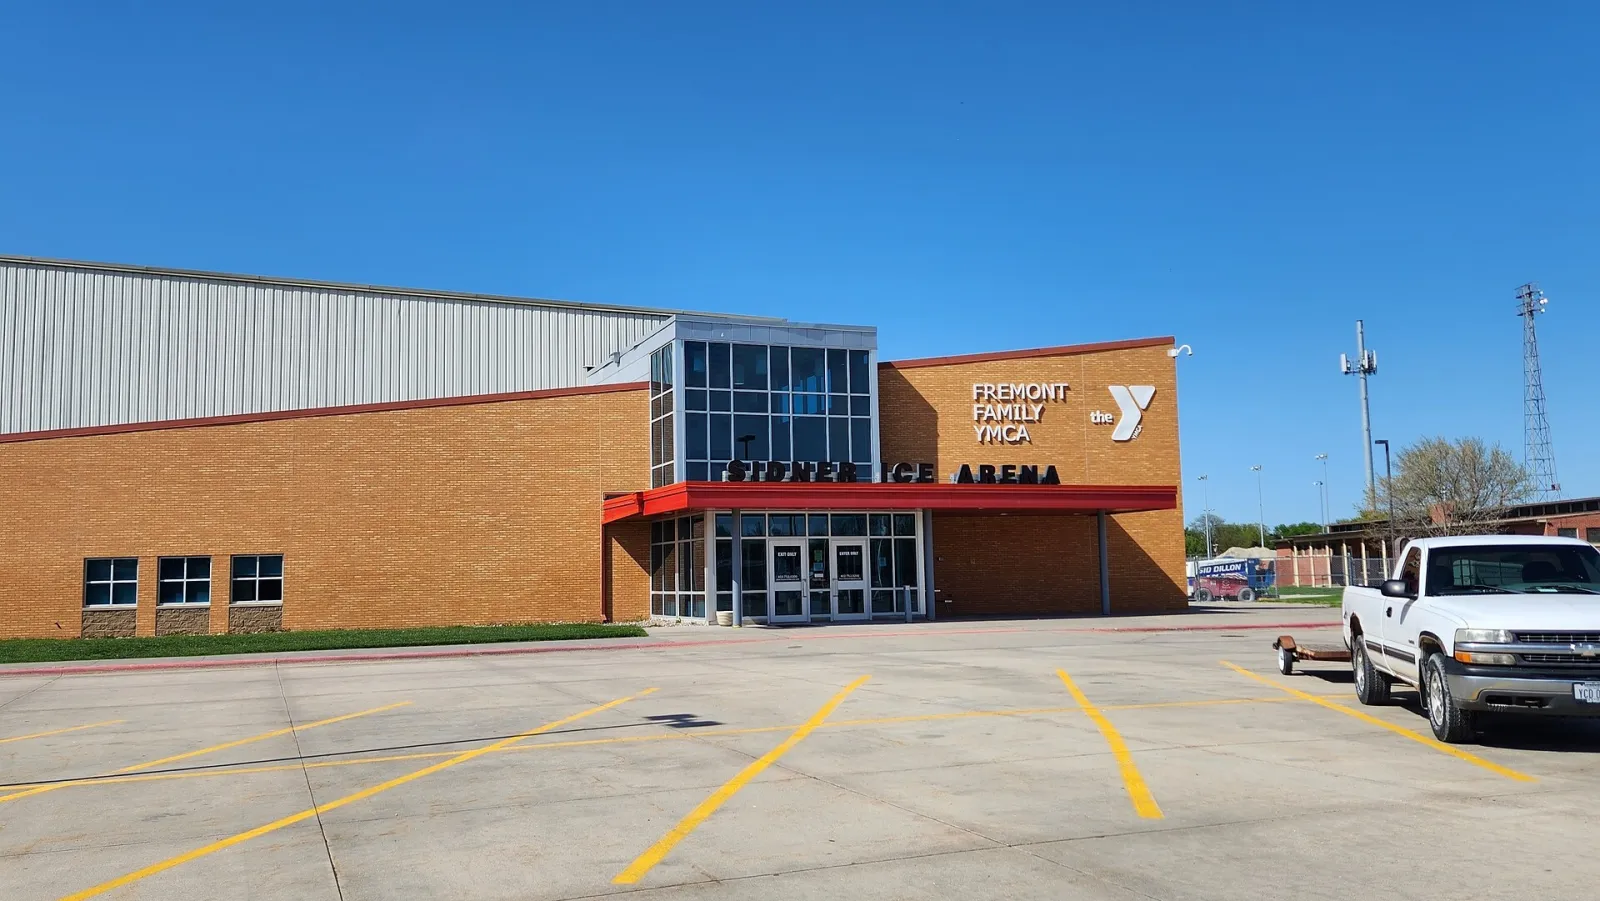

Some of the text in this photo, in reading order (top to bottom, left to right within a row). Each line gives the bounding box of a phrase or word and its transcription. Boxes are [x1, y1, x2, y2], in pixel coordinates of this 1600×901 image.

[973, 383, 1069, 400] FREMONT
[973, 404, 1044, 420] FAMILY
[1090, 410, 1113, 423] the
[973, 425, 1030, 442] YMCA
[1131, 425, 1144, 440] YMCA
[727, 460, 1061, 485] SIDNER ICE ARENA
[1199, 564, 1242, 574] SID DILLON
